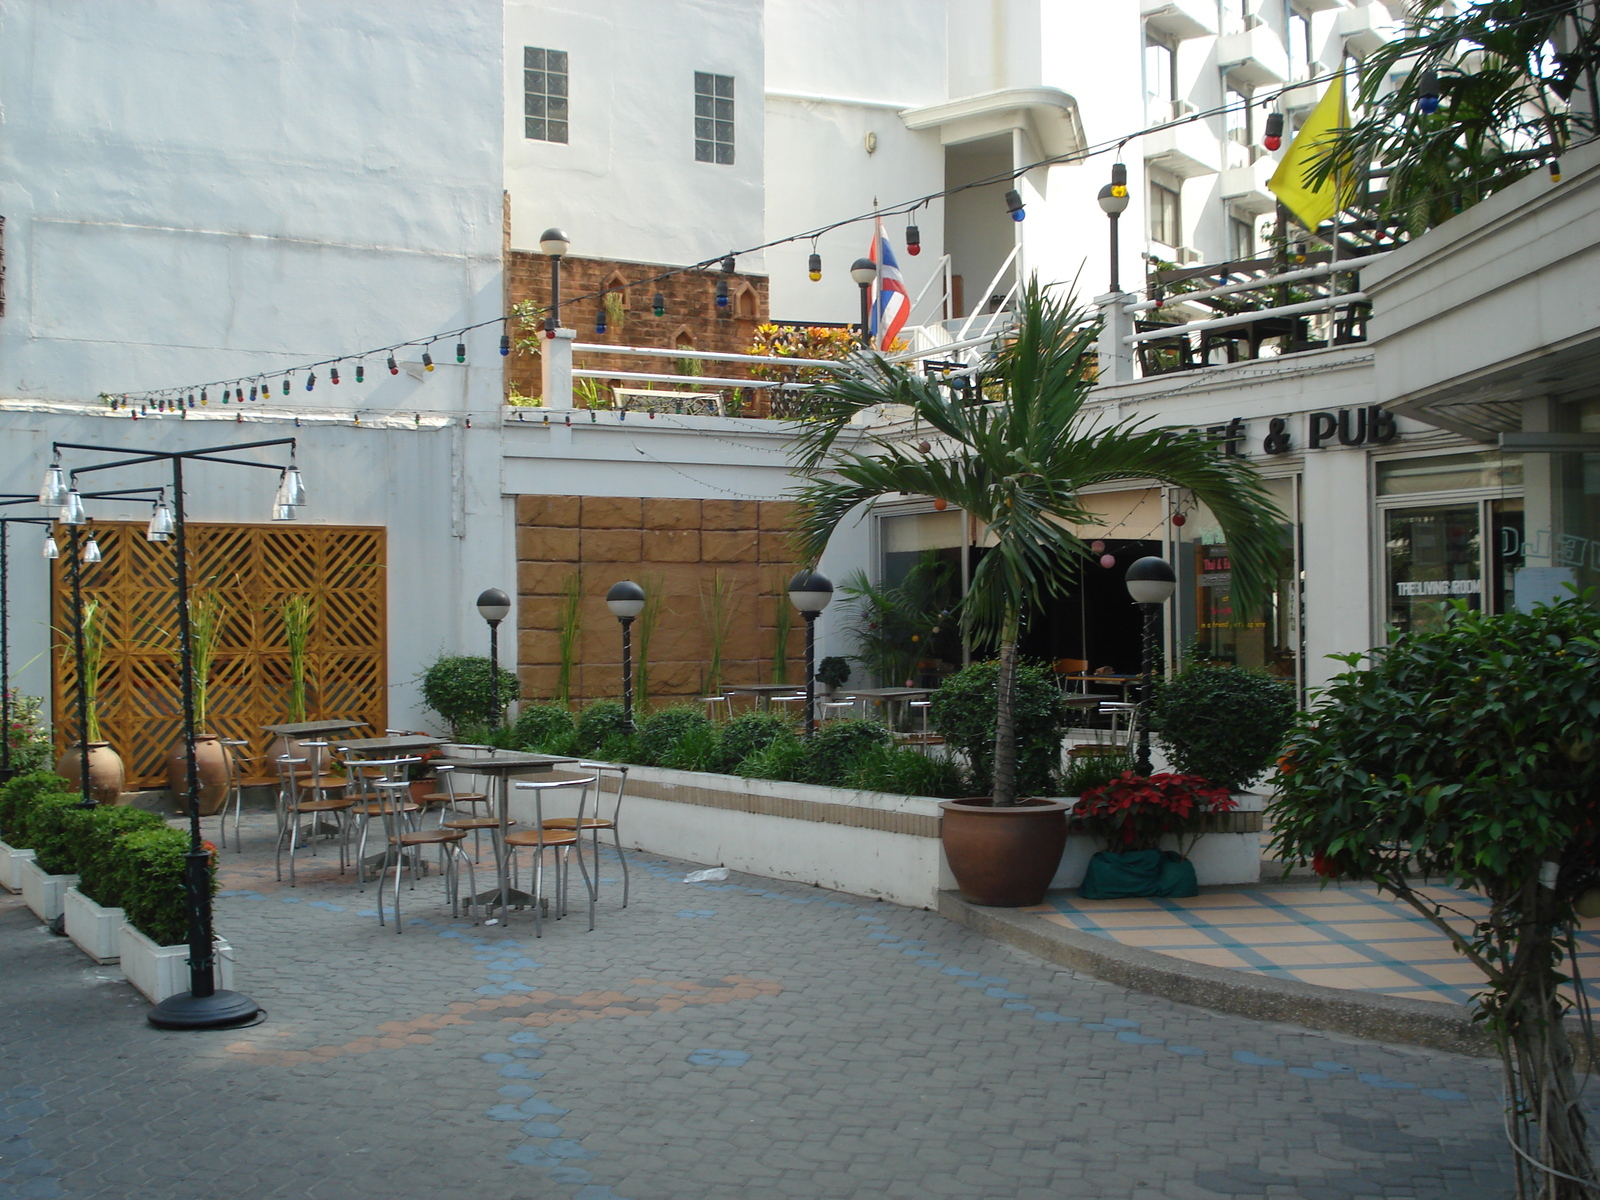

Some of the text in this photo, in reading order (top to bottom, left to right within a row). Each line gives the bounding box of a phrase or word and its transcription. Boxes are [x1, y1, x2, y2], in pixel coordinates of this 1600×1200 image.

[1264, 417, 1291, 455] &
[1309, 406, 1397, 449] PUB
[1419, 580, 1450, 596] LIVING
[1451, 579, 1481, 595] ROOM
